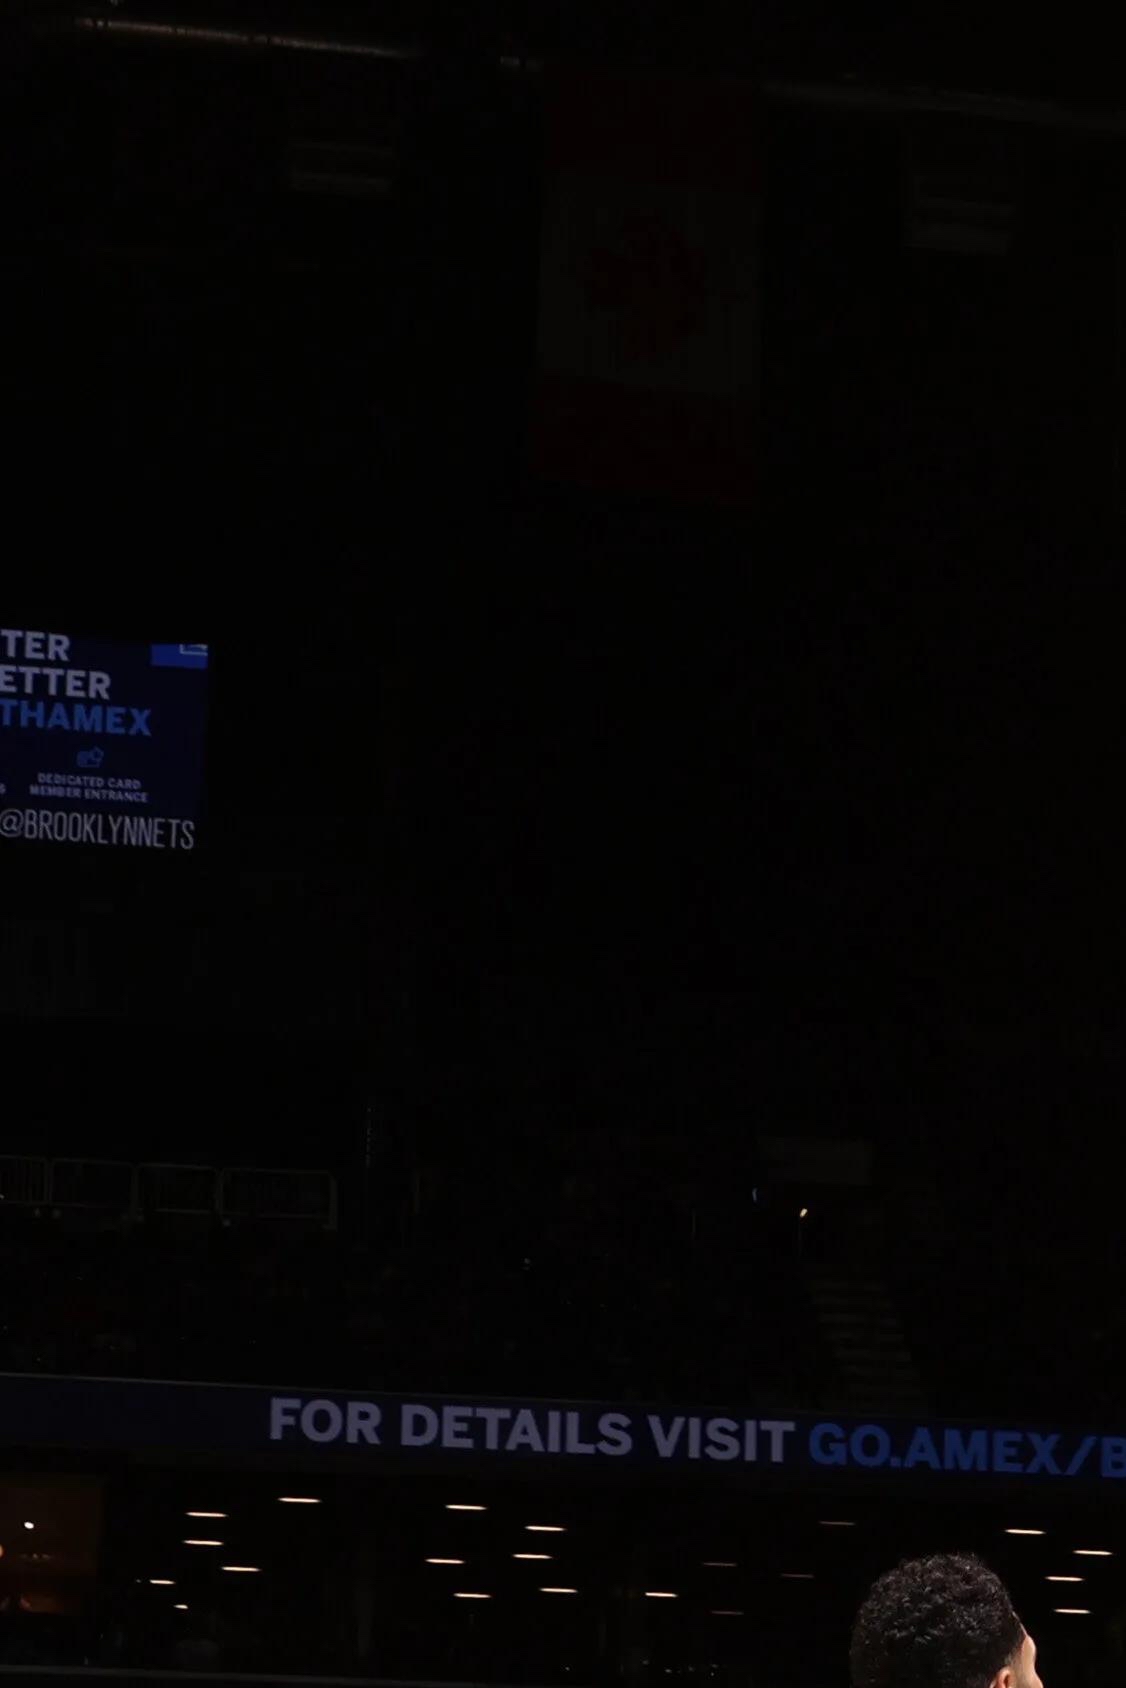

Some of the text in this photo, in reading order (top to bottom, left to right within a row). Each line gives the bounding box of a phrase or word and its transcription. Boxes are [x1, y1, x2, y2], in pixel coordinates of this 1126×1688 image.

[0, 628, 71, 662] TER
[0, 663, 111, 700] ETTER
[0, 698, 152, 736] THAMEX
[29, 785, 149, 803] MEMBER ENTRANCE
[37, 772, 142, 790] DEDICATED CARD
[0, 808, 196, 849] @BROOKLYNNETS
[268, 1397, 383, 1445] FOR
[400, 1403, 634, 1456] DETAILS
[646, 1414, 797, 1463] VISIT
